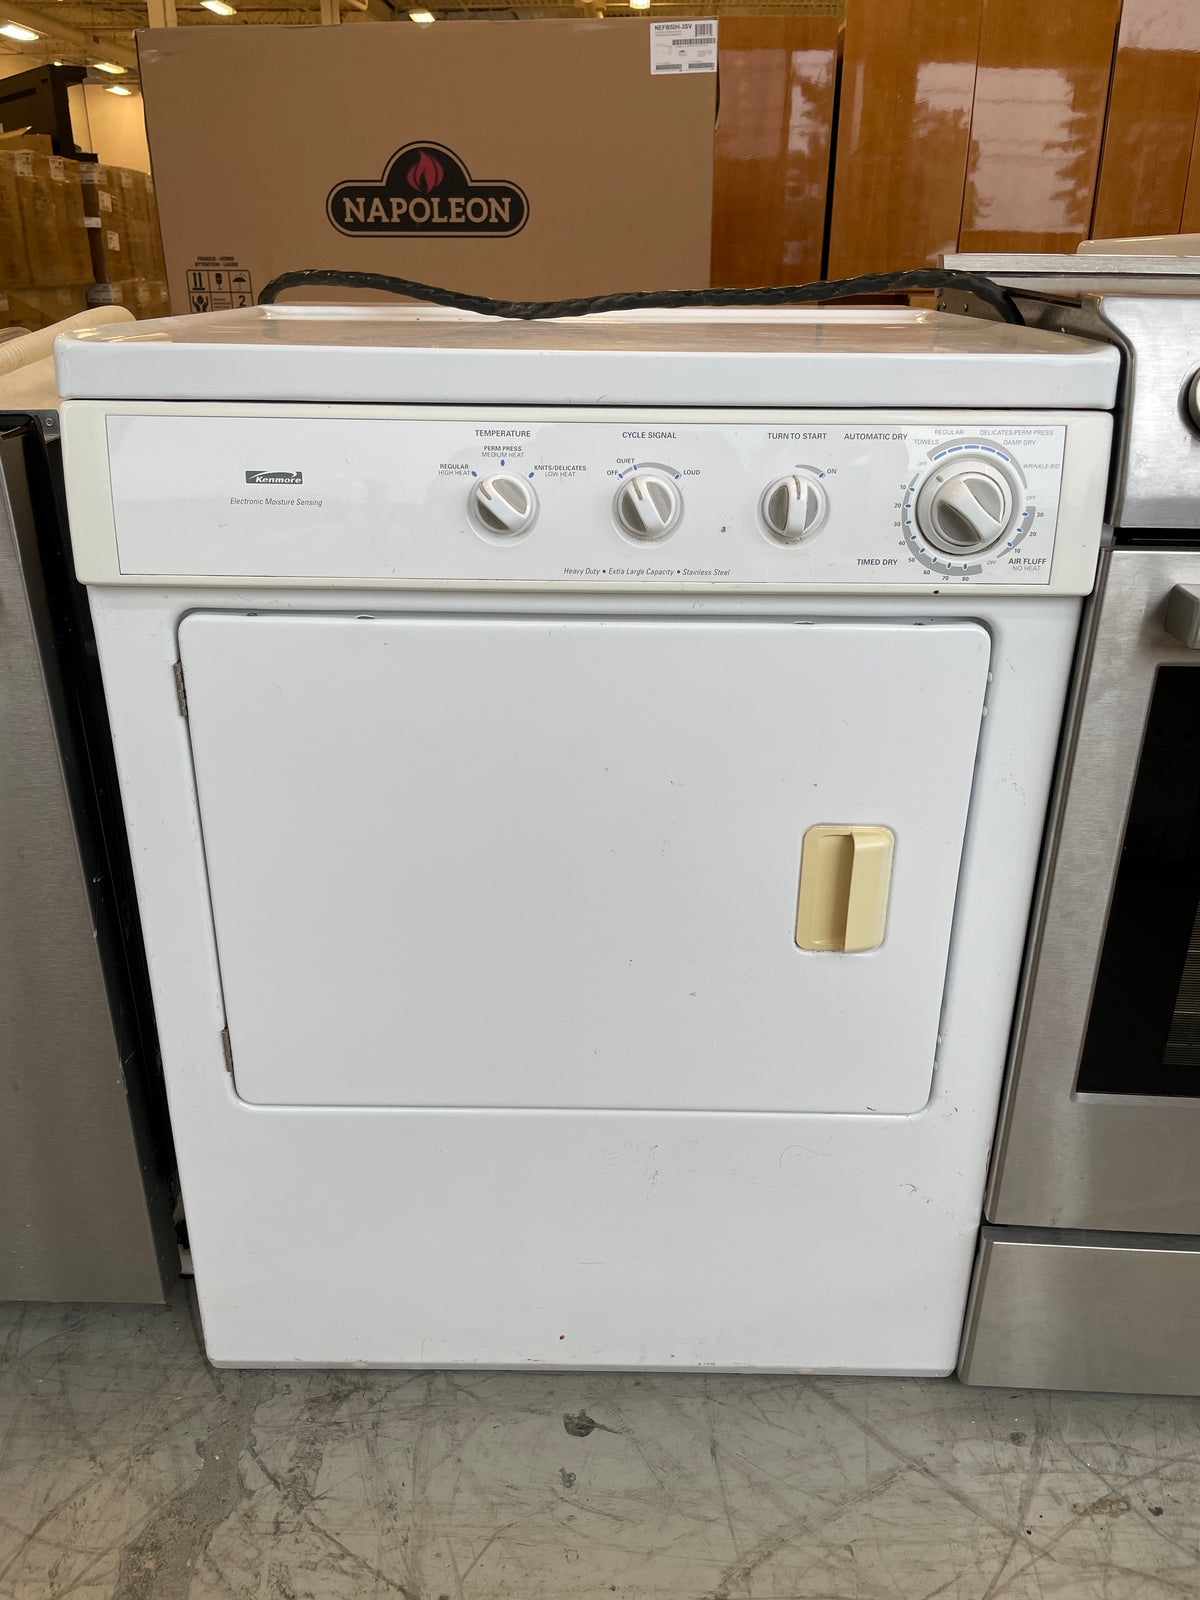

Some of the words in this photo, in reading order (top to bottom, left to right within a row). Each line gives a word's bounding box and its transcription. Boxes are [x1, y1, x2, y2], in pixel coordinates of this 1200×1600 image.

[342, 197, 512, 224] NAPOLEON
[475, 429, 531, 437] TEMPERATURE
[622, 431, 646, 439] CYCLE
[648, 431, 677, 439] SIGNAL
[767, 432, 790, 440] TURN
[790, 432, 801, 440] TO
[802, 432, 827, 440] START
[255, 476, 302, 484] Kenmore
[230, 497, 263, 505] Electronic
[264, 497, 295, 505] Moisture
[296, 498, 323, 507] Sensing
[857, 558, 880, 566] TIMED
[882, 558, 898, 566] DRY
[563, 567, 584, 575] Heavy
[585, 568, 600, 576] Duty
[626, 568, 644, 576] Large
[645, 568, 675, 576] Capacity
[682, 568, 712, 576] Stainless
